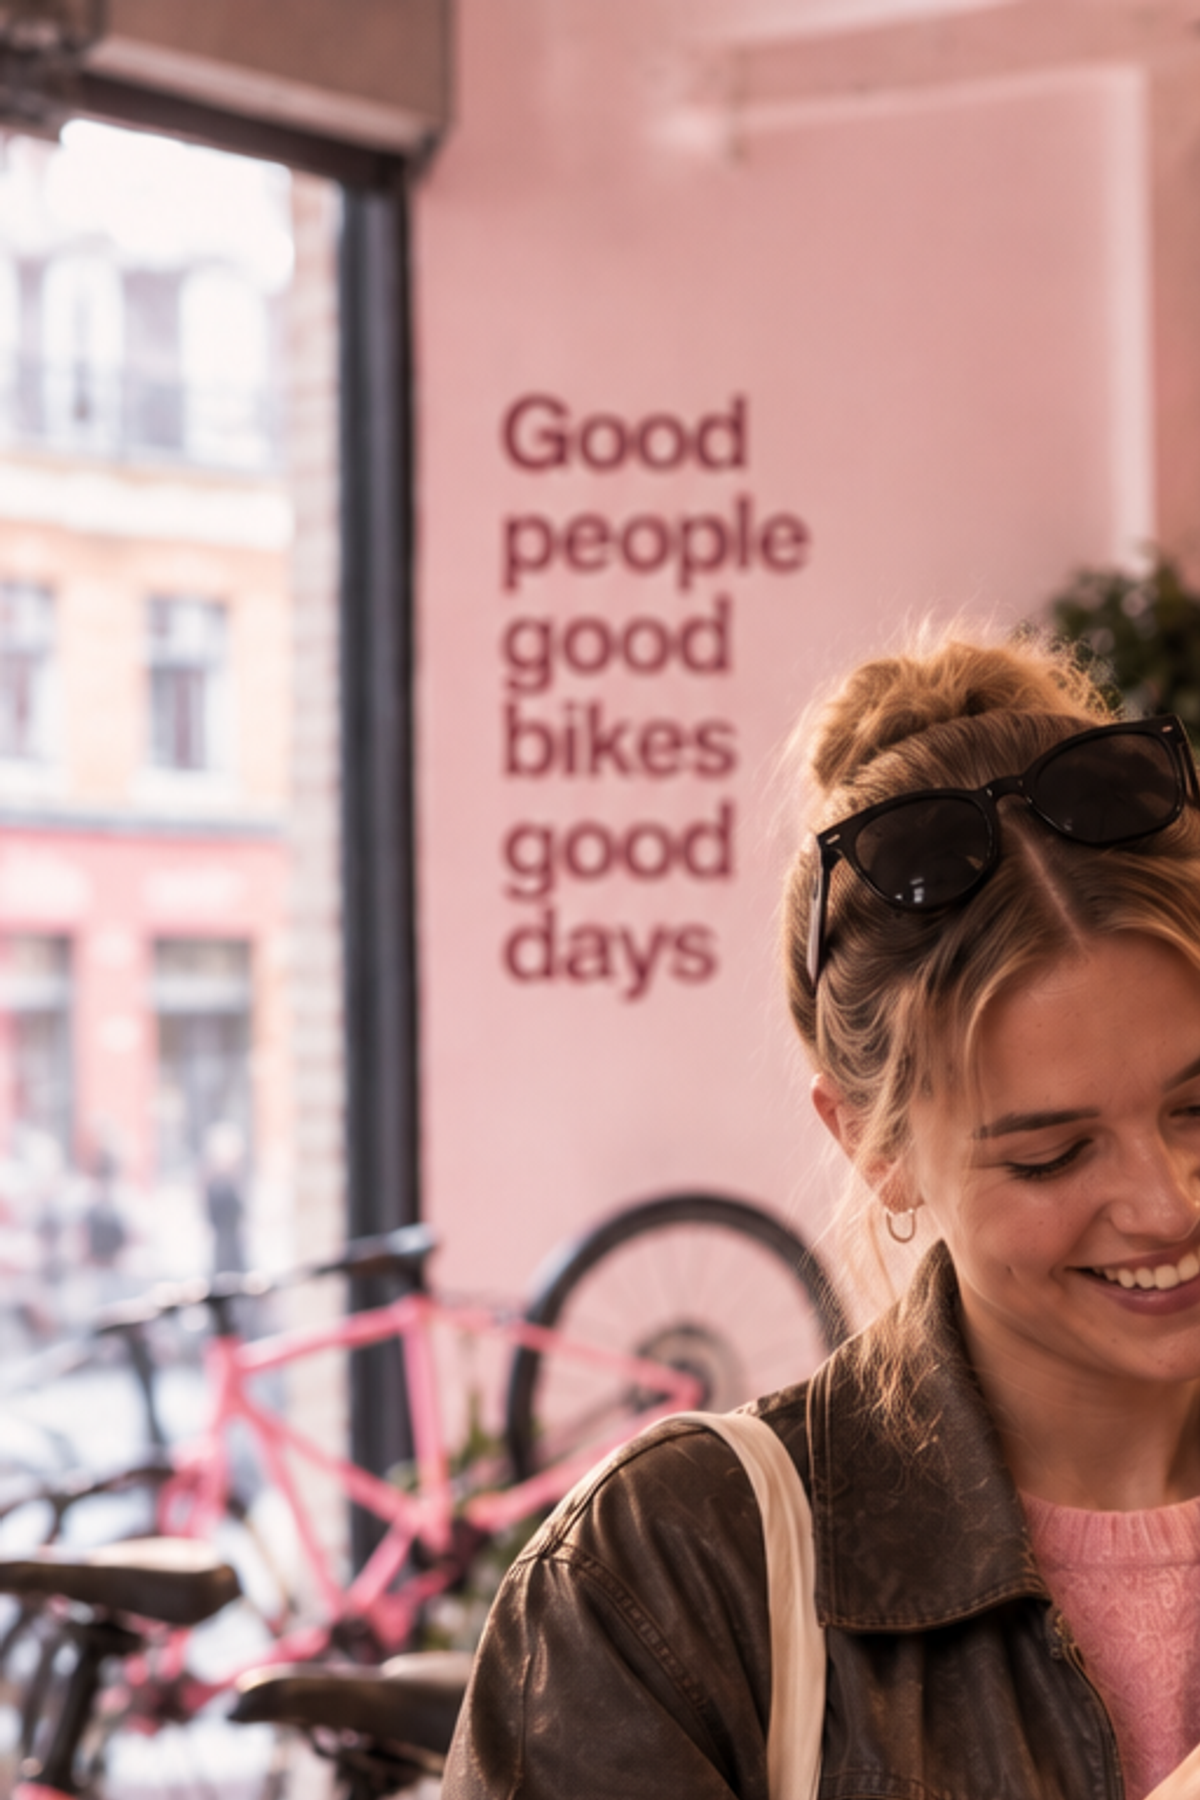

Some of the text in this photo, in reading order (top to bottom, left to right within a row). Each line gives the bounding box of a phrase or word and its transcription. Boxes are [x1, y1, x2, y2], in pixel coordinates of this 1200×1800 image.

[500, 394, 748, 473] Good
[502, 493, 810, 594] people
[501, 593, 733, 696] good
[502, 698, 739, 780] bikes
[502, 798, 737, 902] good
[501, 904, 719, 1003] days
